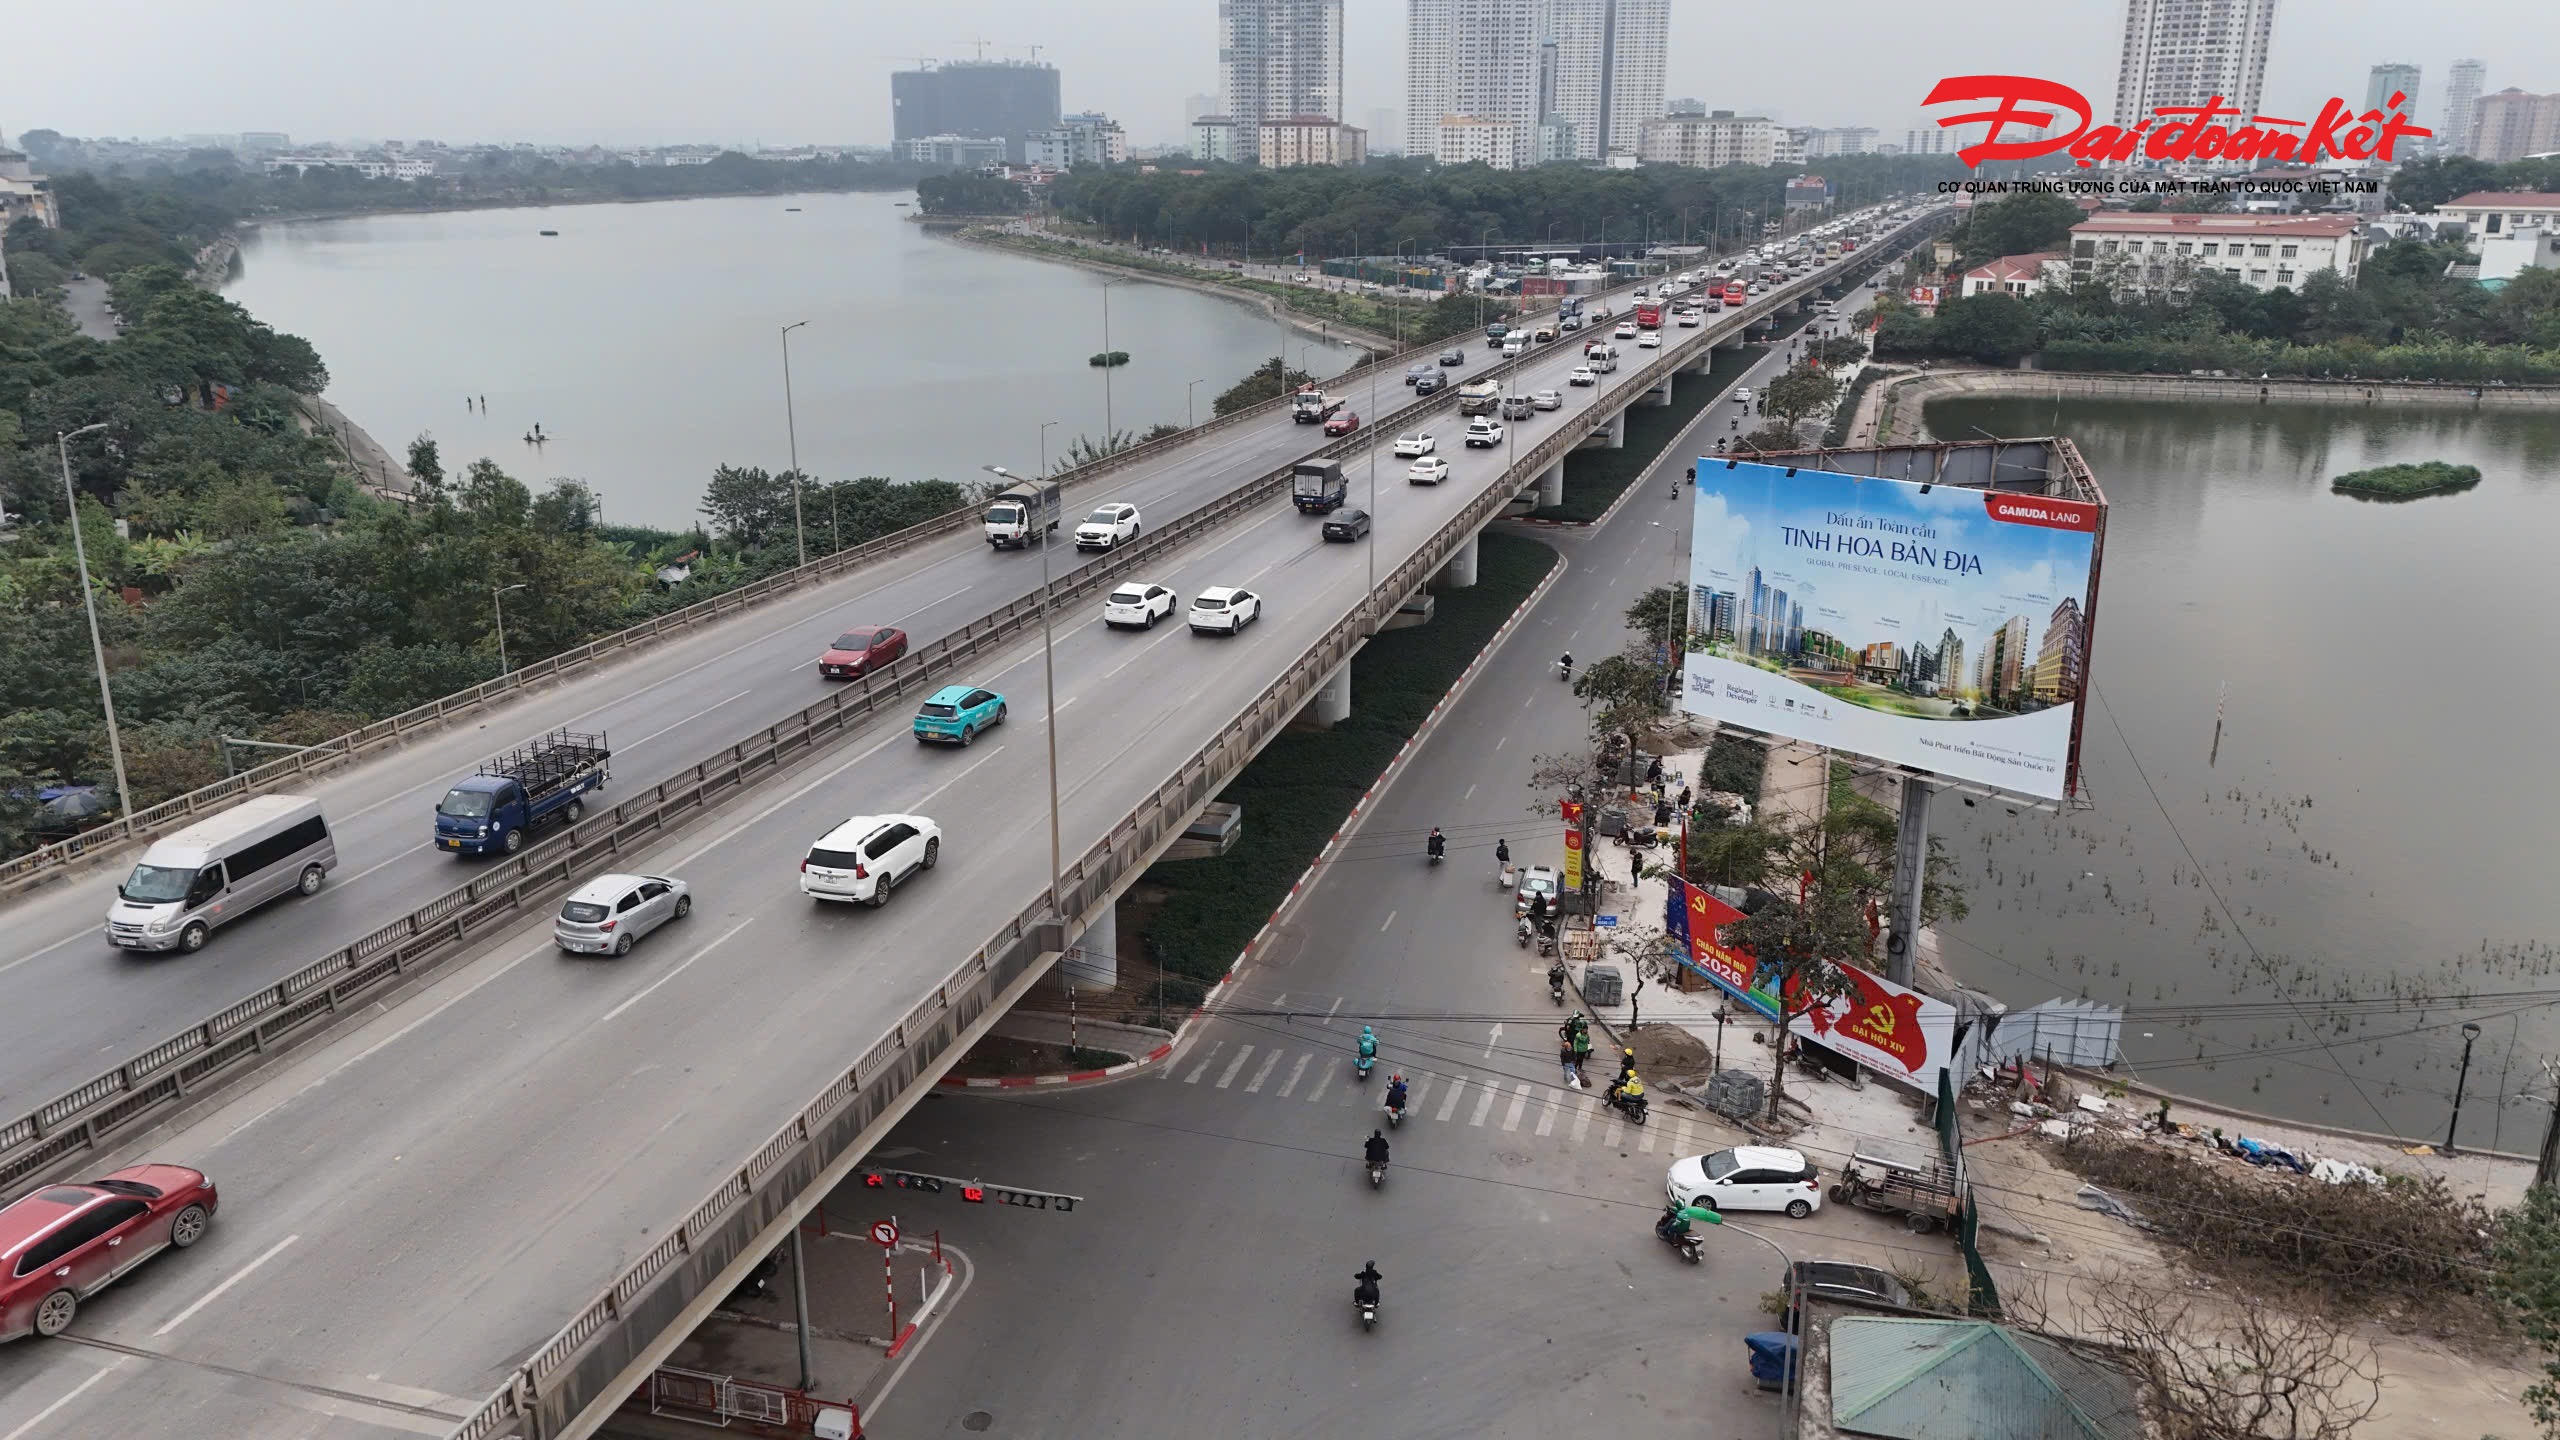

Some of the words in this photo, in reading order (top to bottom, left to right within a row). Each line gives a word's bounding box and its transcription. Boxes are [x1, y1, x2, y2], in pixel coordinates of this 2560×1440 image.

[1827, 511, 1853, 527] Dấu
[1857, 514, 1873, 530] ấn
[1876, 517, 1908, 535] Toàn
[1999, 505, 2047, 520] GAMUDA
[2050, 513, 2080, 523] LAND
[1781, 526, 1830, 551] TINH
[1837, 535, 1883, 559] HOA
[1891, 540, 1936, 567] BẢN
[1943, 550, 1982, 576] ĐỊA
[1806, 557, 1834, 568] GLOBAL
[1883, 568, 1907, 579] LOCAL
[1911, 573, 1949, 586] ESSENCE
[1699, 951, 1743, 987] 2026
[1852, 1024, 1868, 1038] ĐẠI
[1870, 1032, 1887, 1046] HỘI
[1889, 1040, 1906, 1053] XIV
